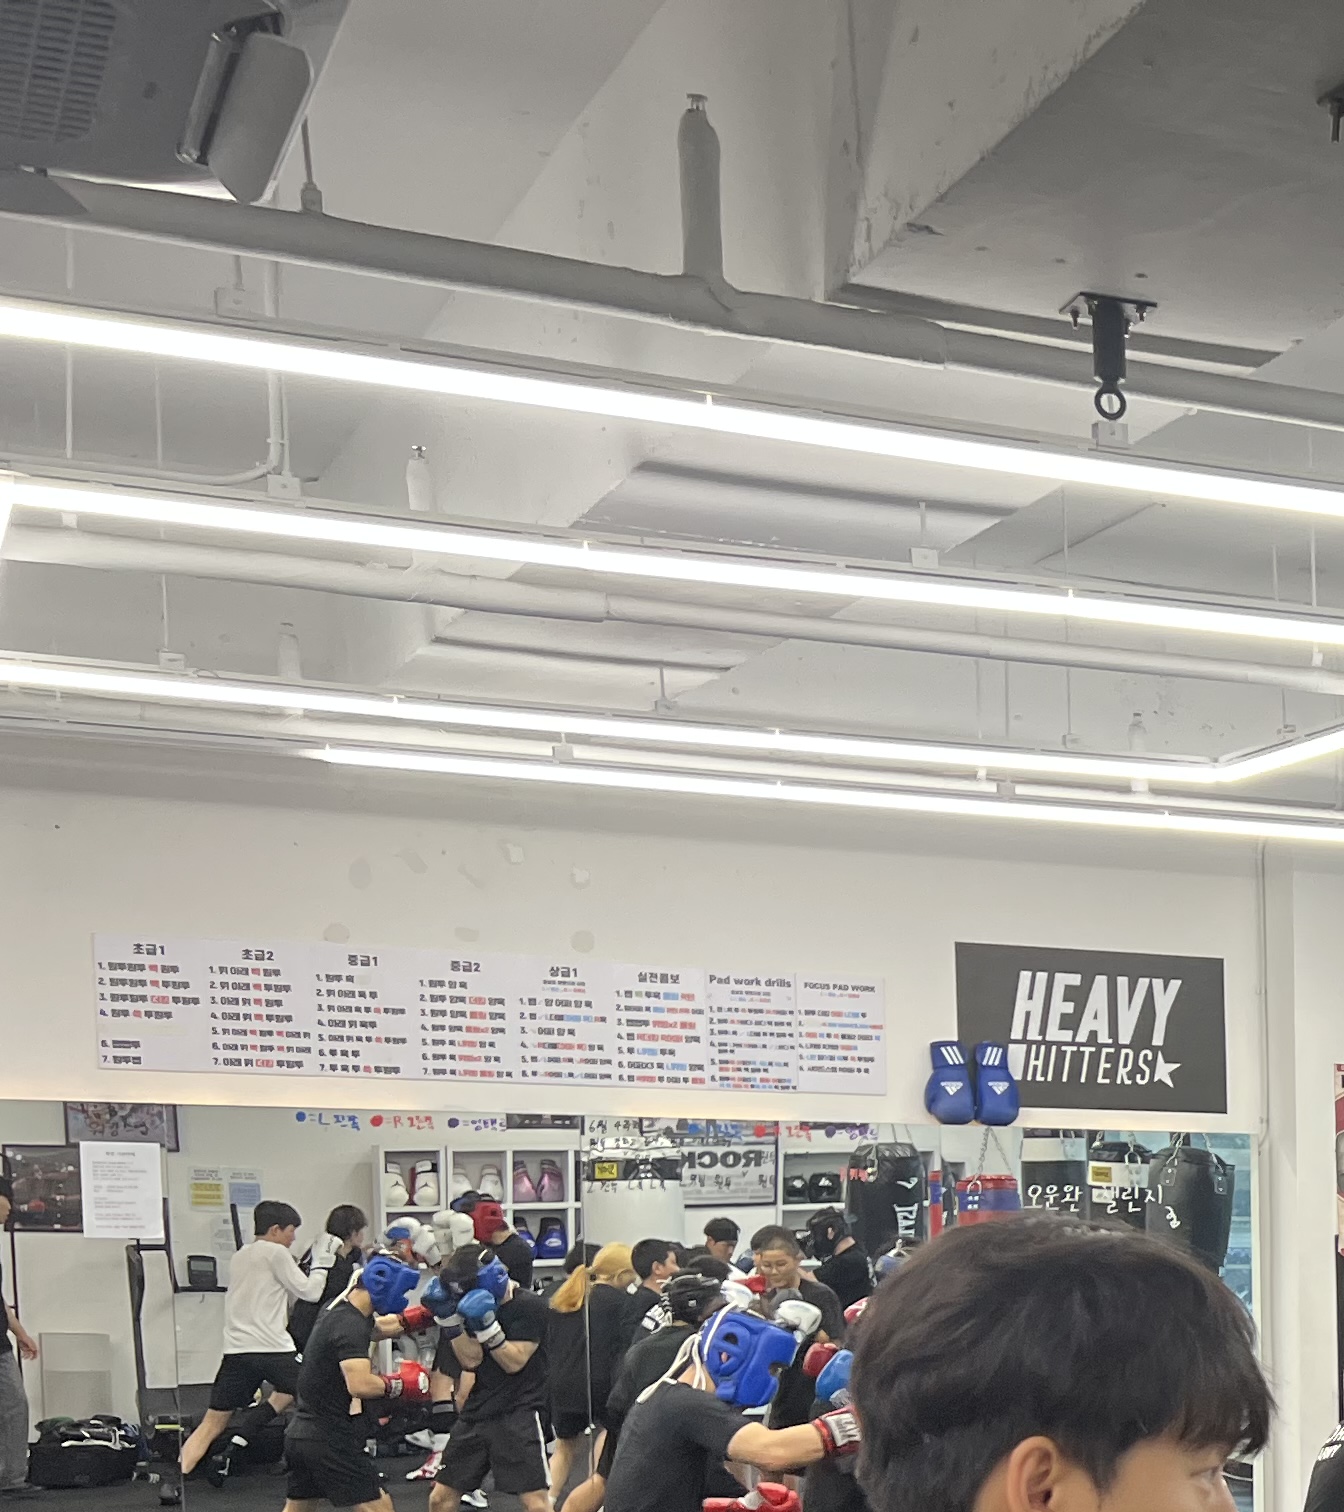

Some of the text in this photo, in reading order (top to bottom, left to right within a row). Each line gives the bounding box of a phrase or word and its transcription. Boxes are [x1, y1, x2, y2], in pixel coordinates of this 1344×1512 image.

[709, 974, 791, 988] Pad work drills
[804, 981, 876, 993] FOCUS PAD WORK
[1009, 970, 1182, 1046] HEAVY
[1027, 1045, 1152, 1085] HITTERS
